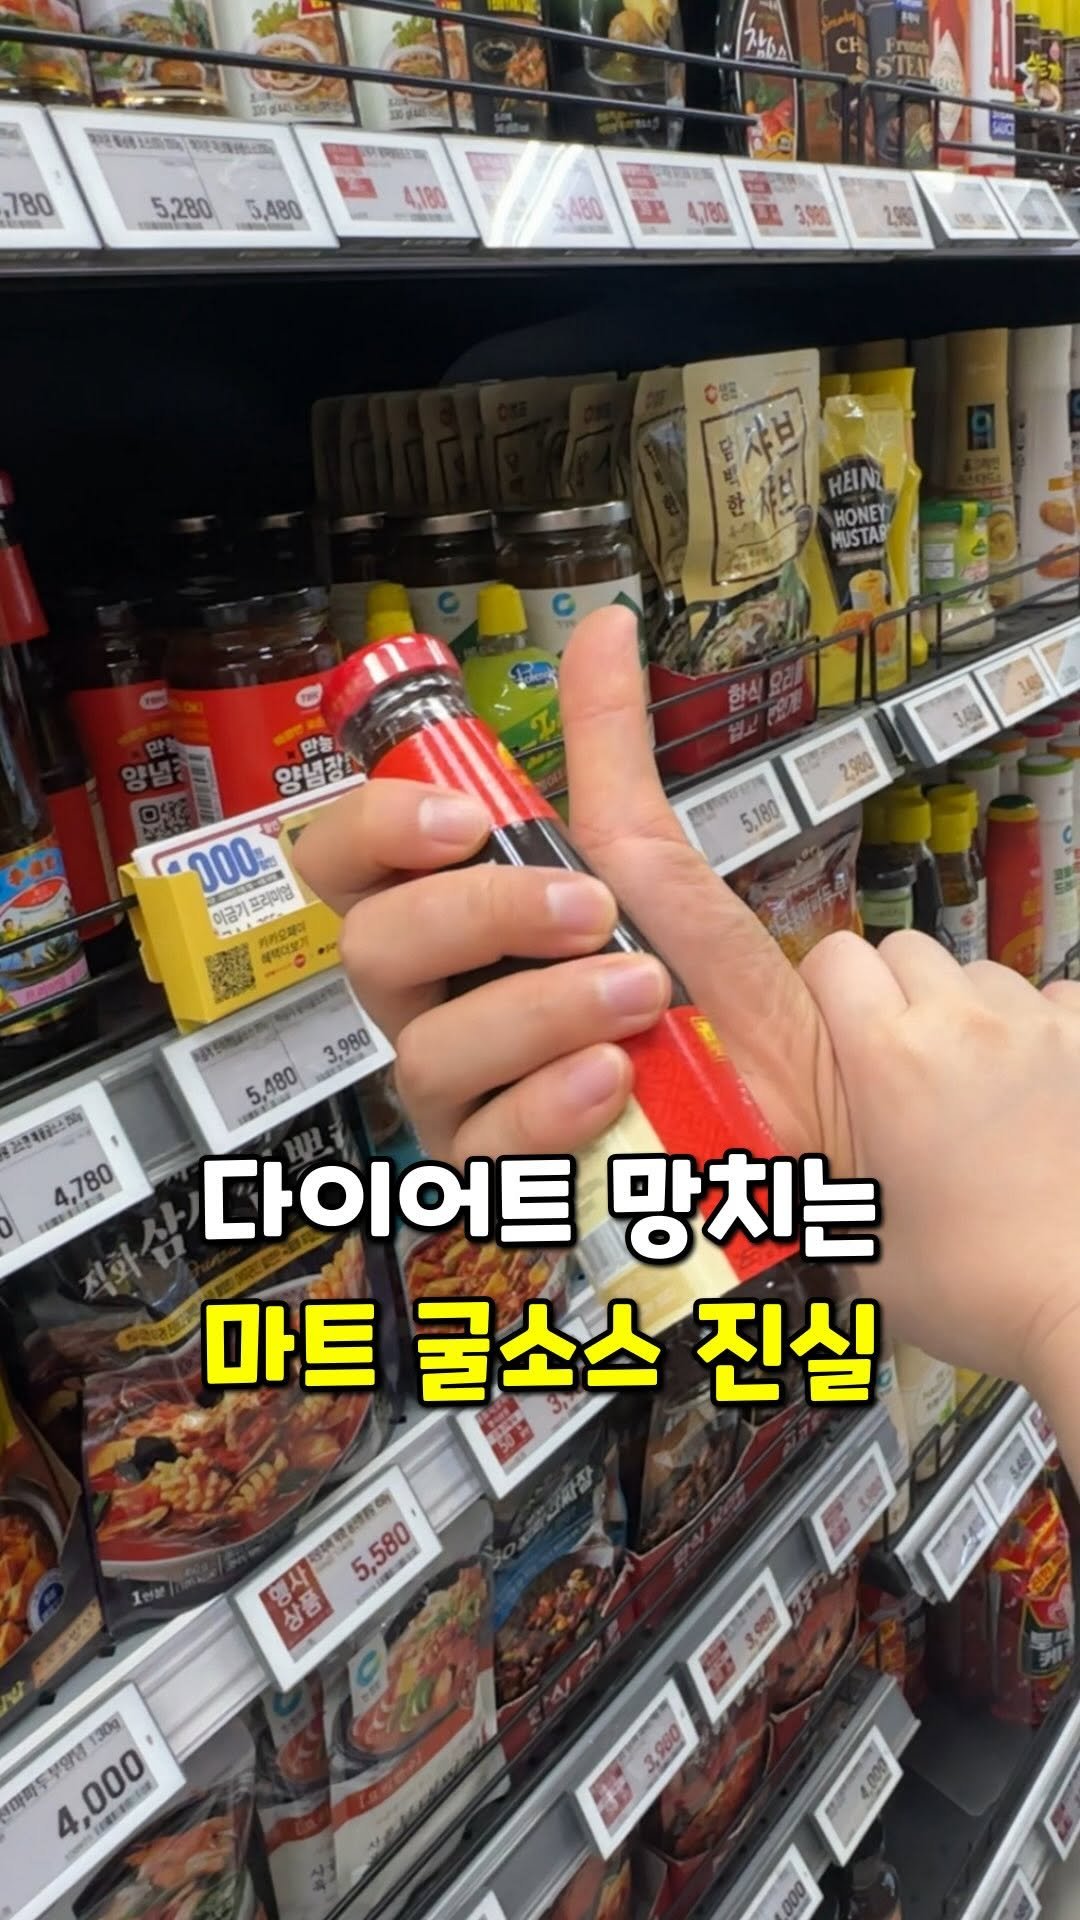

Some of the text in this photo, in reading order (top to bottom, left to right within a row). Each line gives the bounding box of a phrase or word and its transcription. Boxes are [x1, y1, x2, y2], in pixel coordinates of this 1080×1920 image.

[2, 192, 54, 219] ,780
[151, 197, 213, 219] 5,280
[246, 200, 303, 220] 5,480
[403, 185, 448, 209] 4,180
[687, 201, 730, 226] 4,780
[828, 467, 884, 499] HEINZ
[834, 502, 888, 528] HONEY
[830, 522, 891, 551] MUSTAR
[728, 676, 764, 713] 한식
[300, 734, 334, 758] 만능
[275, 752, 346, 797] 양념장
[839, 751, 875, 784] 2,980
[740, 799, 780, 834] 5,180
[213, 903, 250, 926] 이금기
[251, 884, 295, 914] 프리미엄
[259, 921, 307, 949] 카카오페이
[323, 1027, 371, 1064] 3,980
[245, 1066, 298, 1105] 5,480
[54, 1163, 114, 1208] 4,780
[350, 1521, 413, 1583] 5,580
[269, 1561, 311, 1602] 행사
[283, 1591, 325, 1633] 상품
[88, 1717, 121, 1746] 130g
[644, 1722, 682, 1775] 3,980
[58, 1748, 145, 1839] 4,000
